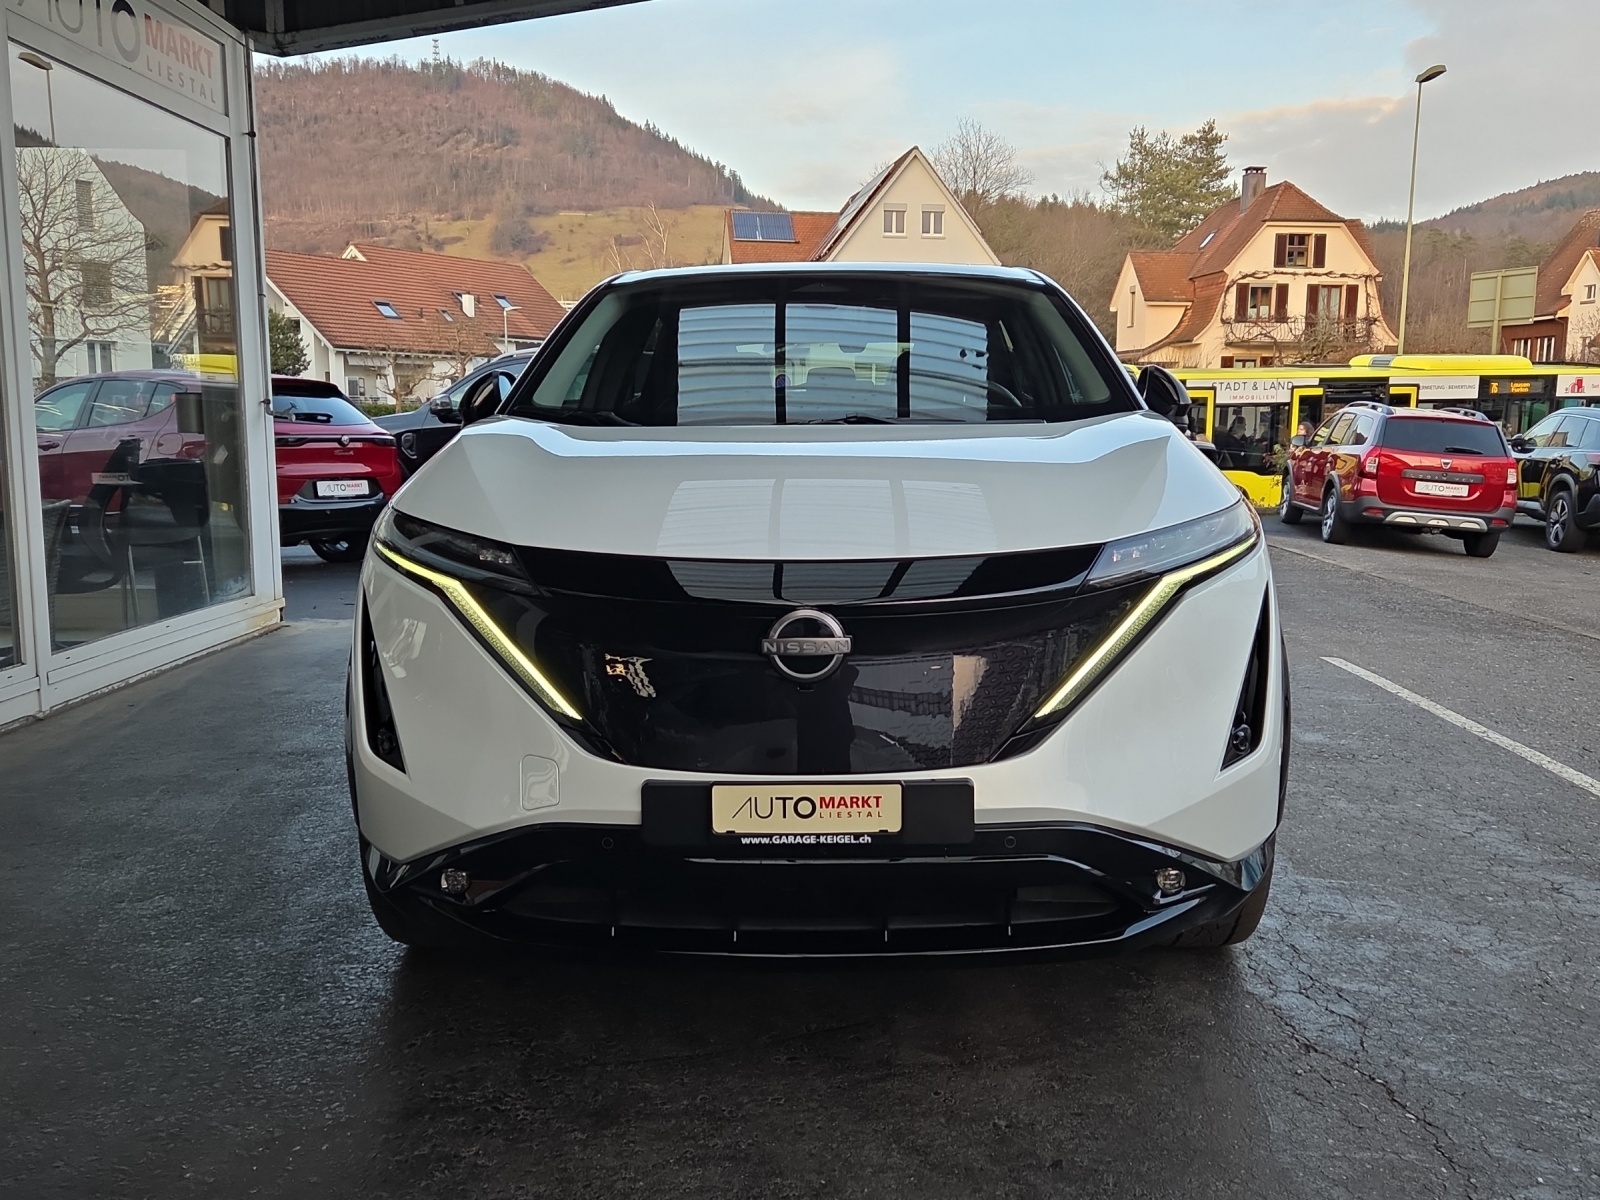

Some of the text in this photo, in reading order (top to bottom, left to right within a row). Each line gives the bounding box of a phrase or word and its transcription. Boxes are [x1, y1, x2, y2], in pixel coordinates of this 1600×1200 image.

[143, 13, 214, 79] MARKT
[146, 54, 216, 104] LIESTAL
[1251, 381, 1259, 391] &
[1263, 380, 1294, 391] LAND
[324, 484, 346, 492] AUTO
[763, 640, 849, 653] NISSAN
[732, 795, 883, 819] AUTO MARKT
[819, 810, 883, 818] LIESTAL
[741, 835, 872, 845] www.GARAGE-KEIGEL.ch
